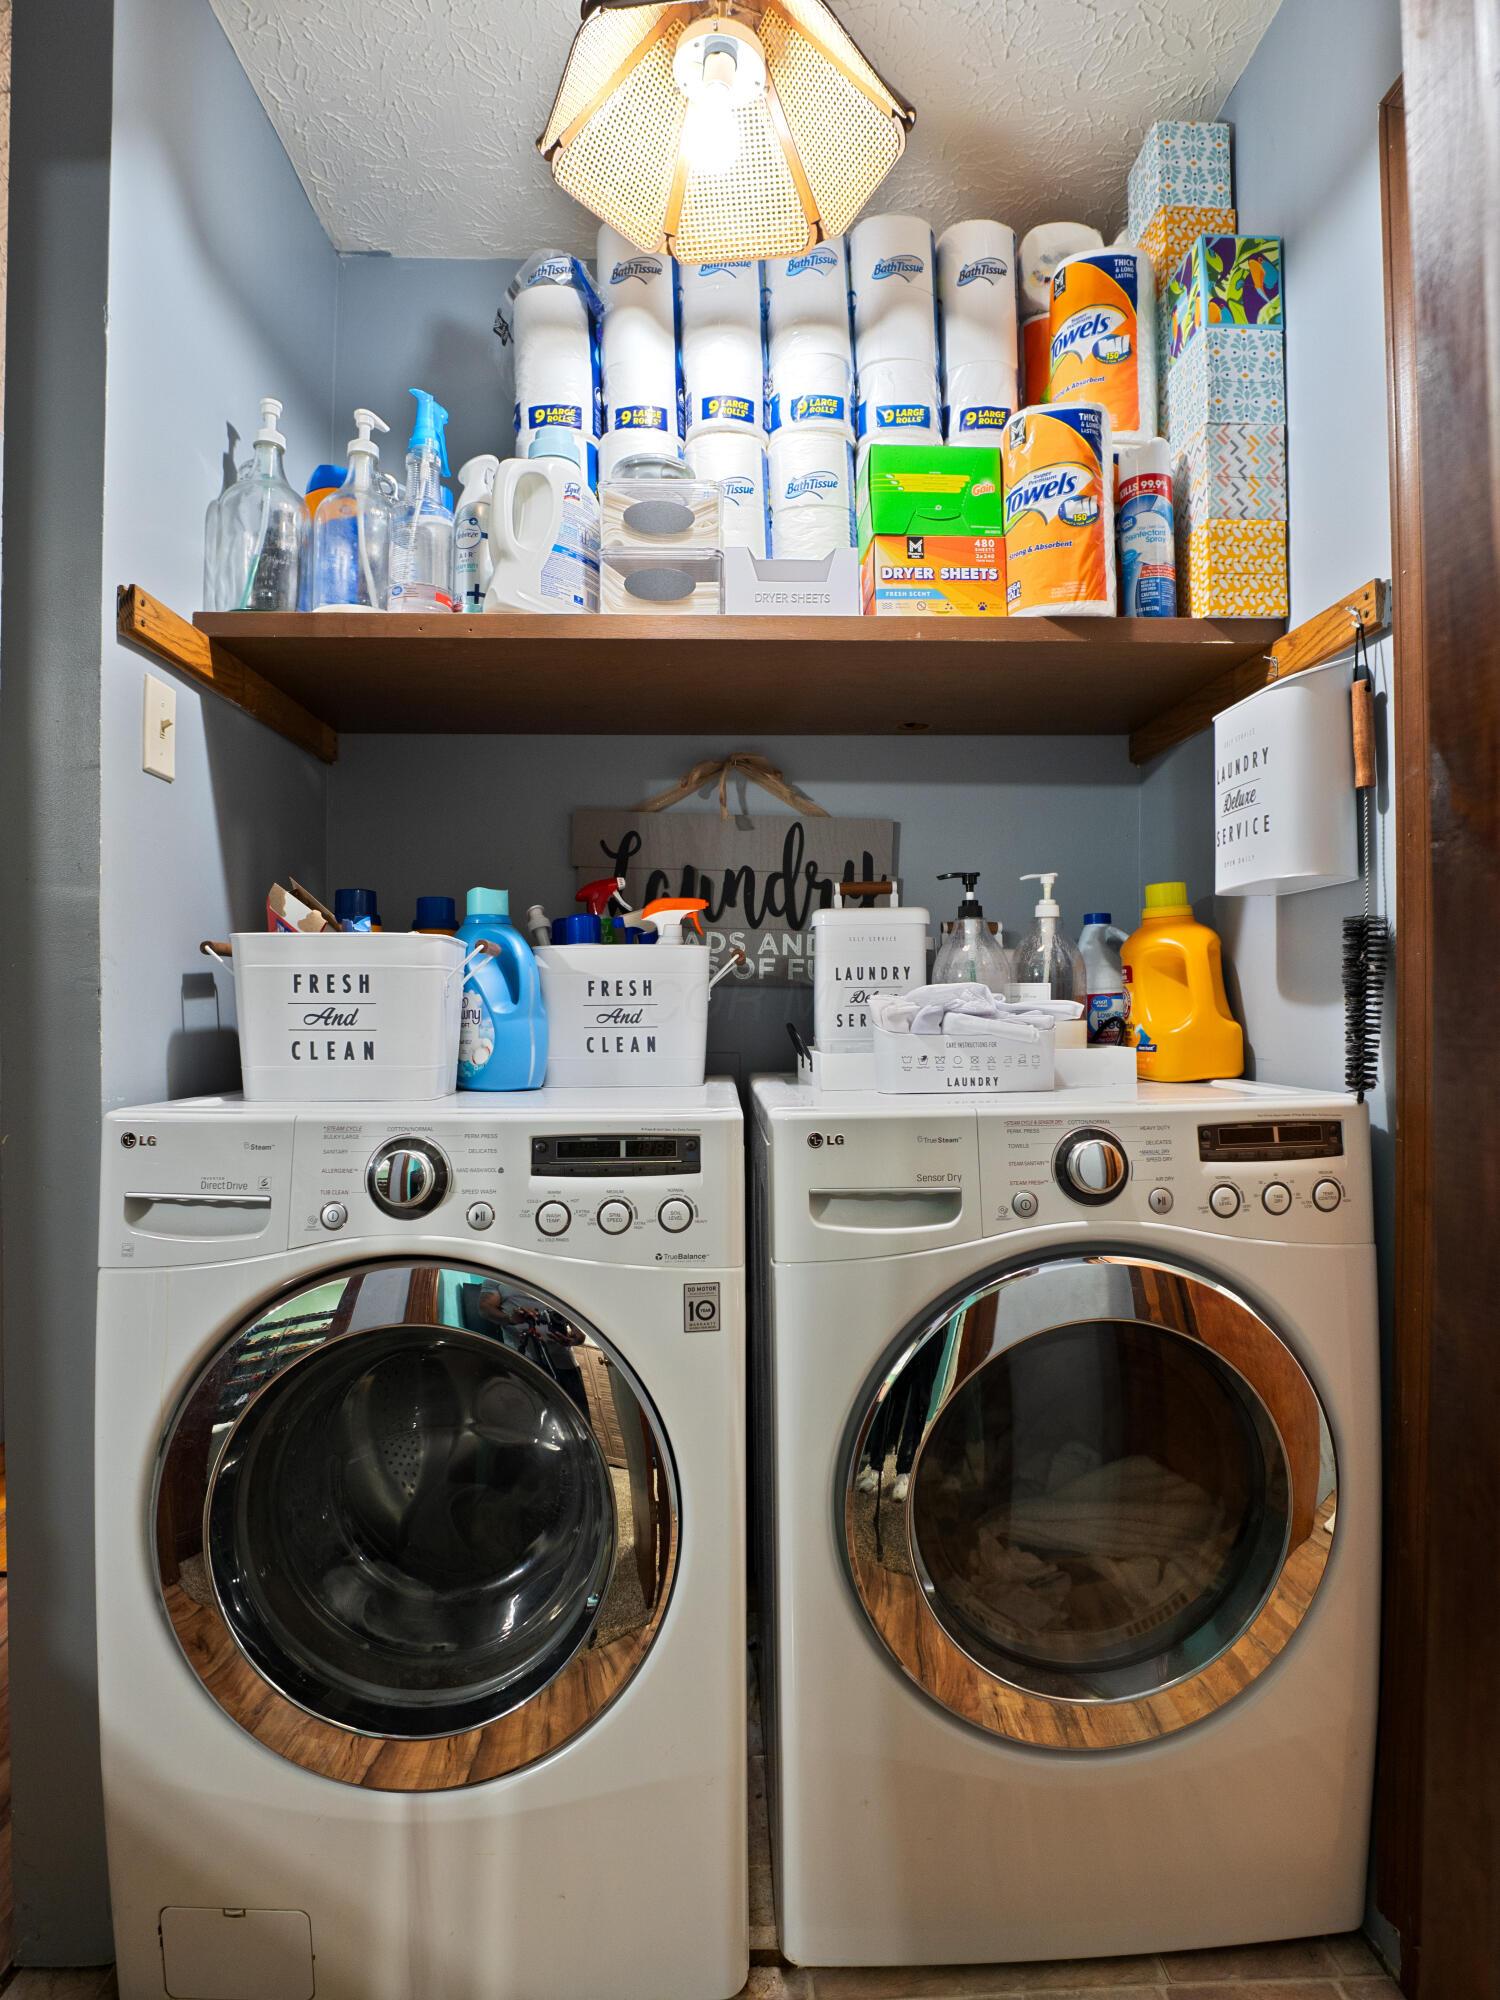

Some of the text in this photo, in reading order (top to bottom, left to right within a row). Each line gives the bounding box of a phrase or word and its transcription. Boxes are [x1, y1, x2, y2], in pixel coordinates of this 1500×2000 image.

[787, 254, 838, 271] BathTissue
[873, 259, 924, 277] BathTissue
[1114, 259, 1134, 267] THICK
[611, 262, 663, 280] BathTissue
[958, 261, 1008, 281] BathTissue
[1051, 313, 1110, 368] Towels
[708, 396, 749, 413] 9 LARGE
[797, 397, 838, 413] 9 LARGE
[535, 408, 576, 424] 9 LARGE
[620, 410, 630, 425] 9
[883, 408, 924, 423] 9 LARGE
[965, 410, 1005, 426] 9 LARGE
[1079, 413, 1099, 422] THICK
[787, 478, 839, 495] BathTissue
[972, 483, 995, 496] Gain
[1006, 472, 1078, 522] Towels
[974, 539, 995, 547] 480
[1034, 541, 1072, 551] Absorbent
[1145, 536, 1166, 544] Spray
[881, 567, 998, 581] DRYER SHEETS
[754, 593, 831, 604] DRYER SHEETS
[1216, 746, 1270, 786] LAUNDRY
[1223, 787, 1257, 814] Deluxe
[1216, 814, 1271, 848] SERVICE
[835, 966, 911, 981] LAUNDRY
[293, 973, 371, 994] FRESH
[587, 979, 653, 997] FRESH
[303, 1007, 359, 1027] And
[596, 1007, 643, 1024] And
[291, 1040, 375, 1061] CLEAN
[586, 1036, 657, 1053] CLEAN
[946, 1076, 999, 1087] LAUNDRY
[139, 1135, 157, 1147] LG
[826, 1135, 844, 1146] LG
[916, 1173, 962, 1184] Sensor Dry
[688, 1300, 716, 1321] 10
